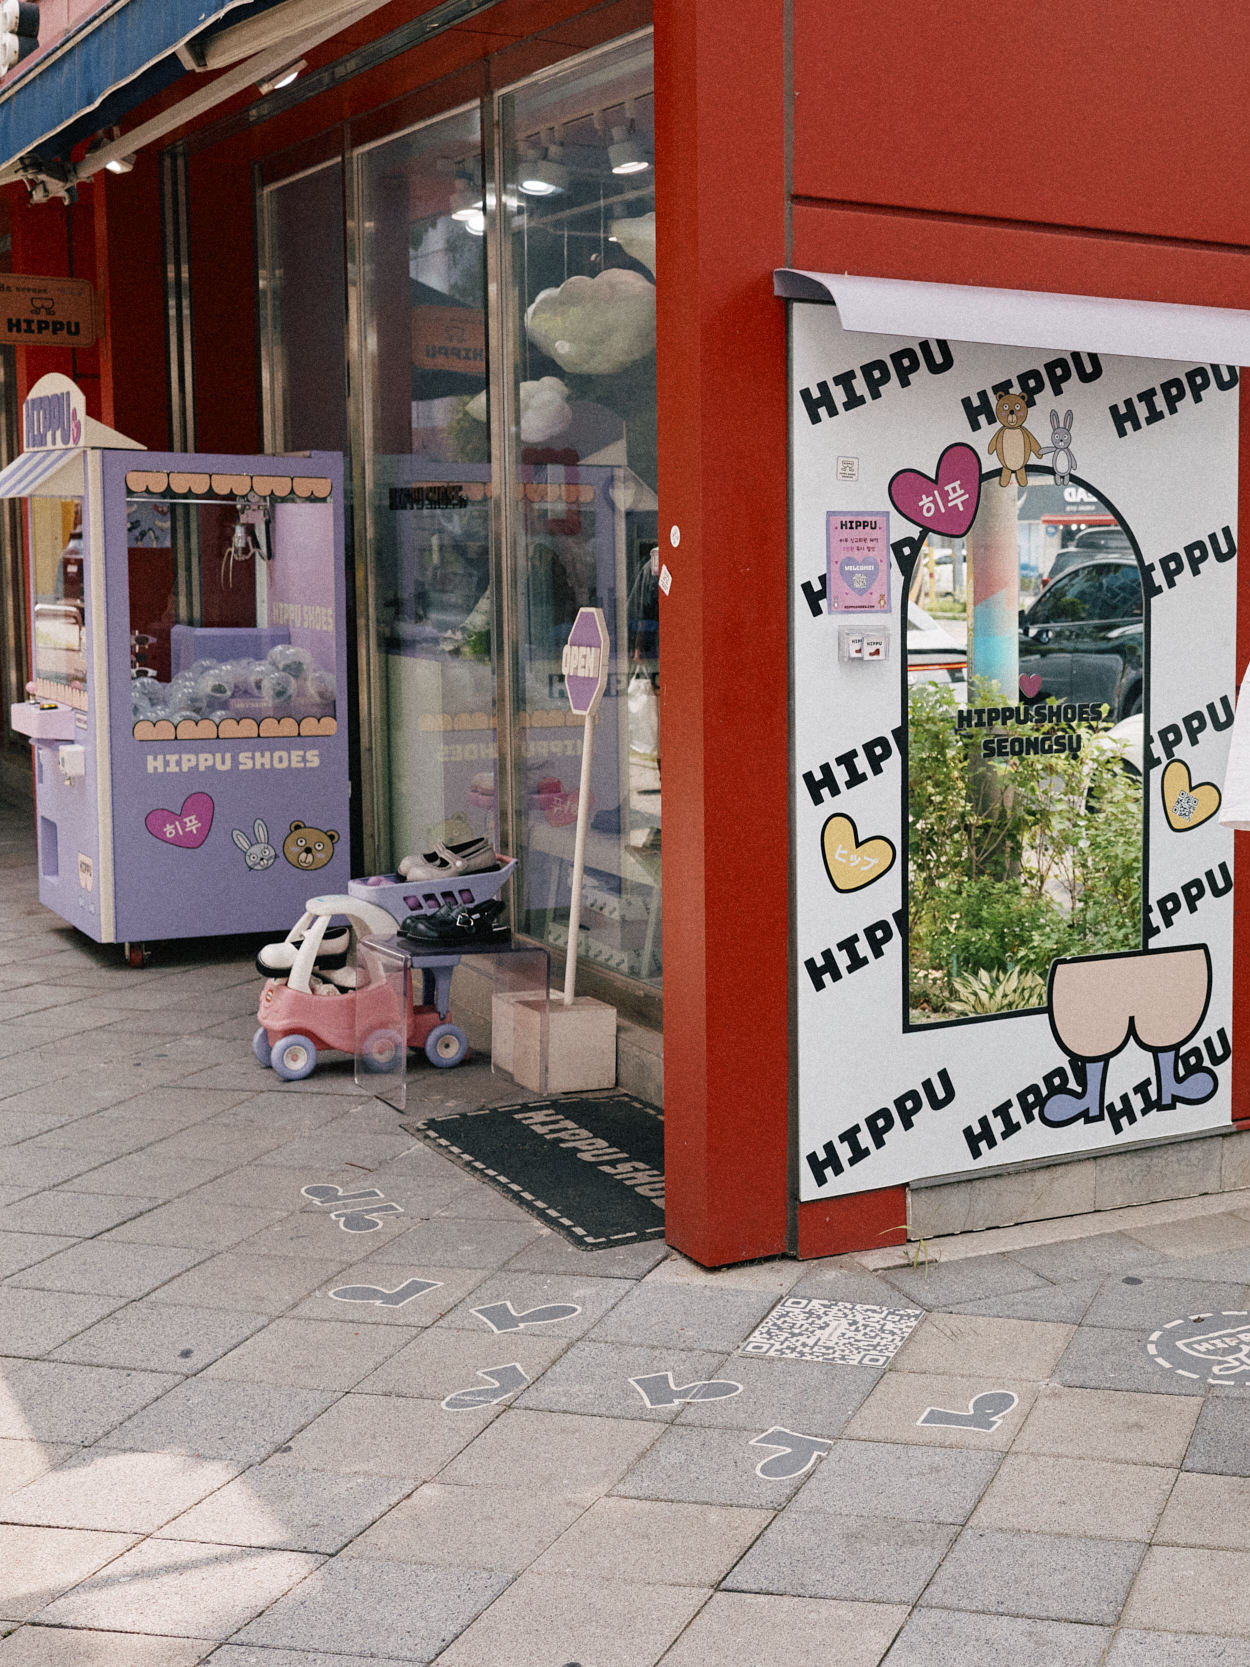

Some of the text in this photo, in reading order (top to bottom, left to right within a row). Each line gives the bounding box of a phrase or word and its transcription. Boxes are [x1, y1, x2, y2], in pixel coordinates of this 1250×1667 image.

[7, 318, 80, 336] HIPPU
[800, 339, 954, 425] HIPPU
[1109, 364, 1239, 438] HIPPU
[25, 391, 70, 448] HIPPU
[840, 520, 877, 530] HIPPU
[918, 481, 969, 517] 히푸
[1146, 525, 1237, 598] IPPU
[562, 645, 597, 678] OPEN
[957, 703, 1102, 729] HIPPU SHOES
[982, 734, 1082, 758] SEONGSU
[1148, 694, 1234, 770] IPPU
[147, 750, 320, 773] HIPPU SHOES
[802, 726, 902, 806] HIP
[163, 815, 202, 838] 히푸
[834, 844, 880, 871] ヒップ
[1147, 860, 1234, 939] IPPU
[804, 909, 902, 992] HIP
[1105, 1027, 1232, 1136] HIPU
[512, 1109, 665, 1210] HIPPU SHO
[806, 1067, 955, 1188] HIPPU
